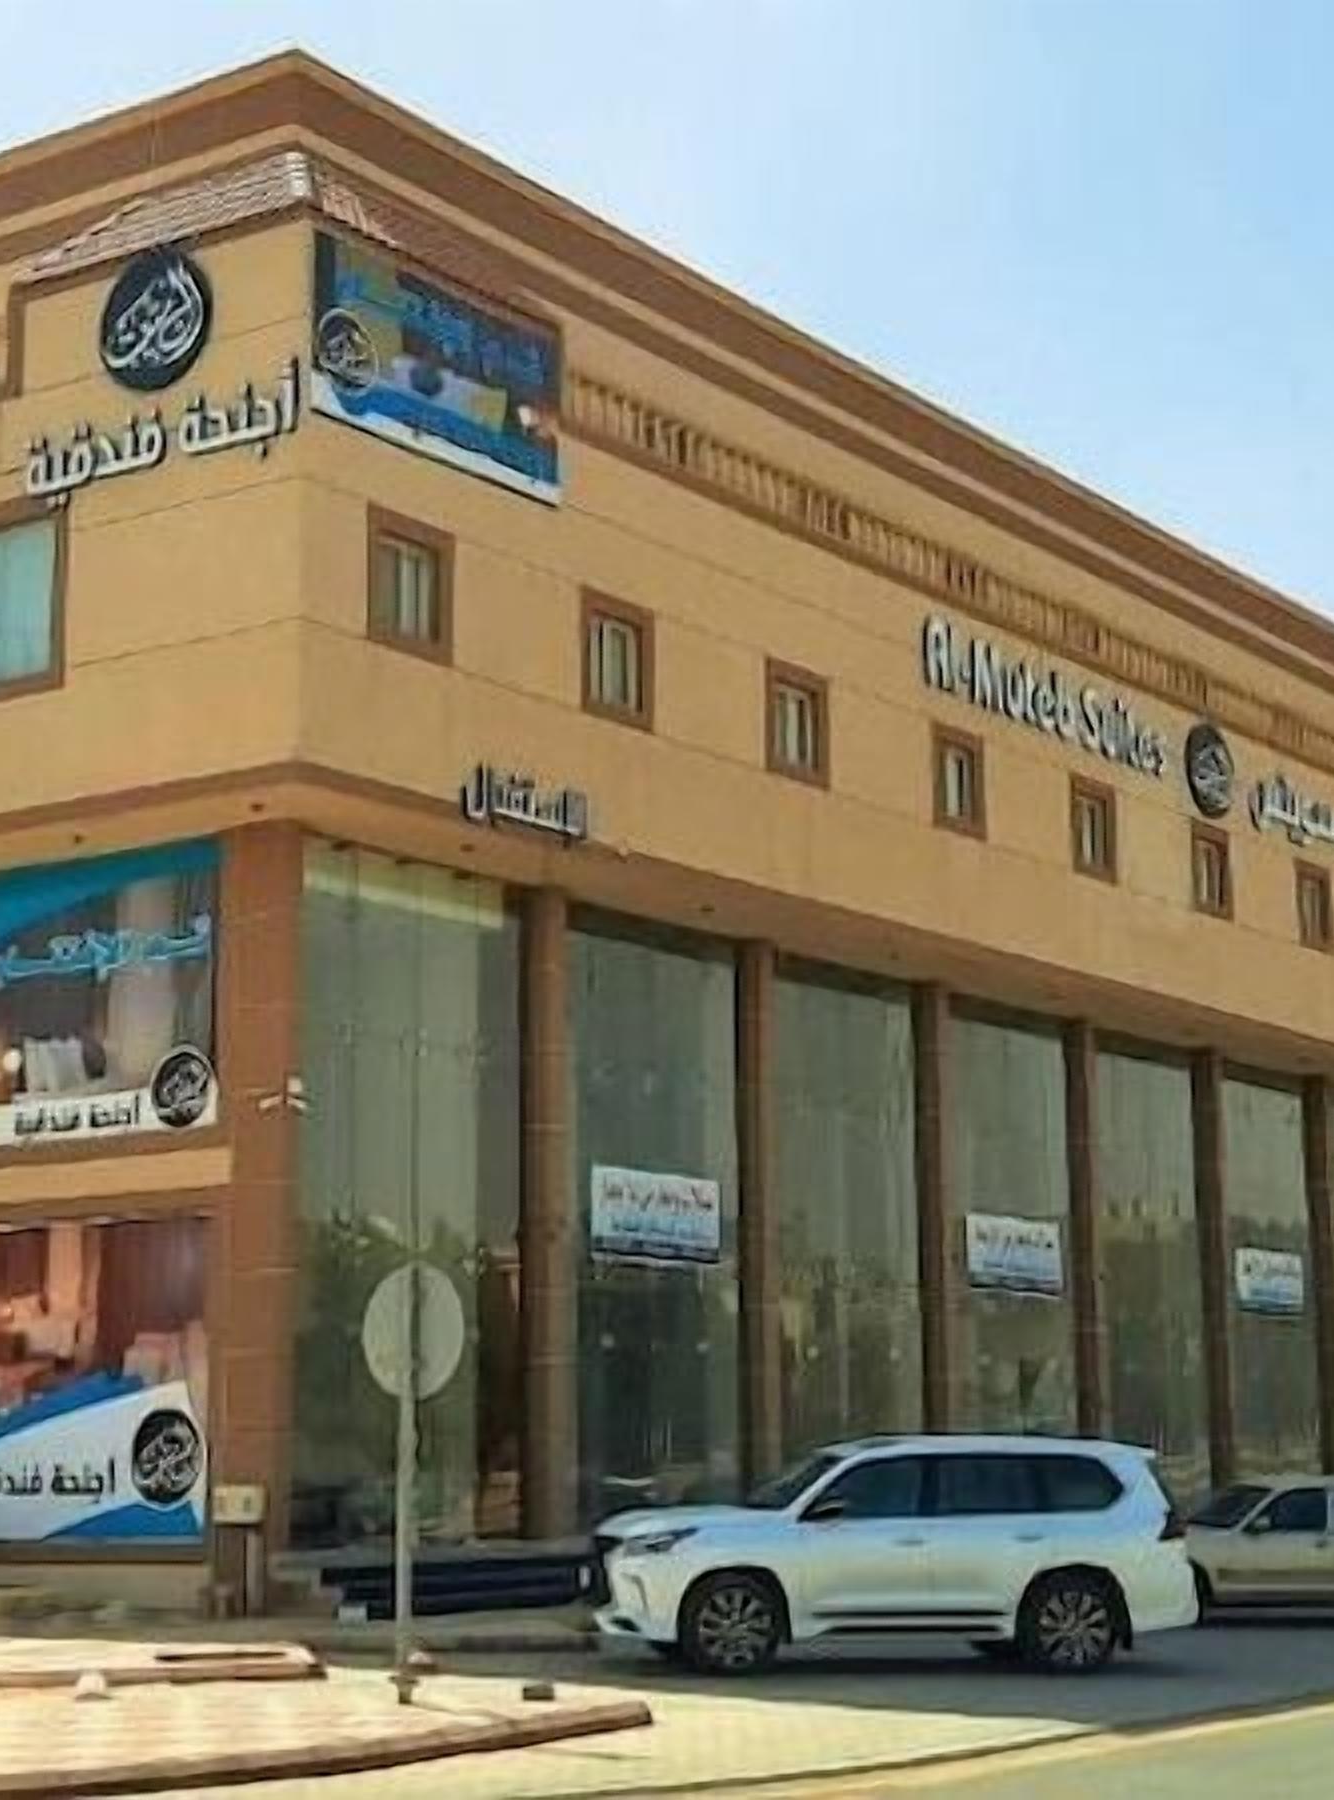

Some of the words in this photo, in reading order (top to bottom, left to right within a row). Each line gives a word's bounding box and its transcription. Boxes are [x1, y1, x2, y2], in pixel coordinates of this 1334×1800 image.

[26, 407, 167, 507] فندقية
[180, 358, 300, 461] أجنحة
[1079, 687, 1165, 776] Suites
